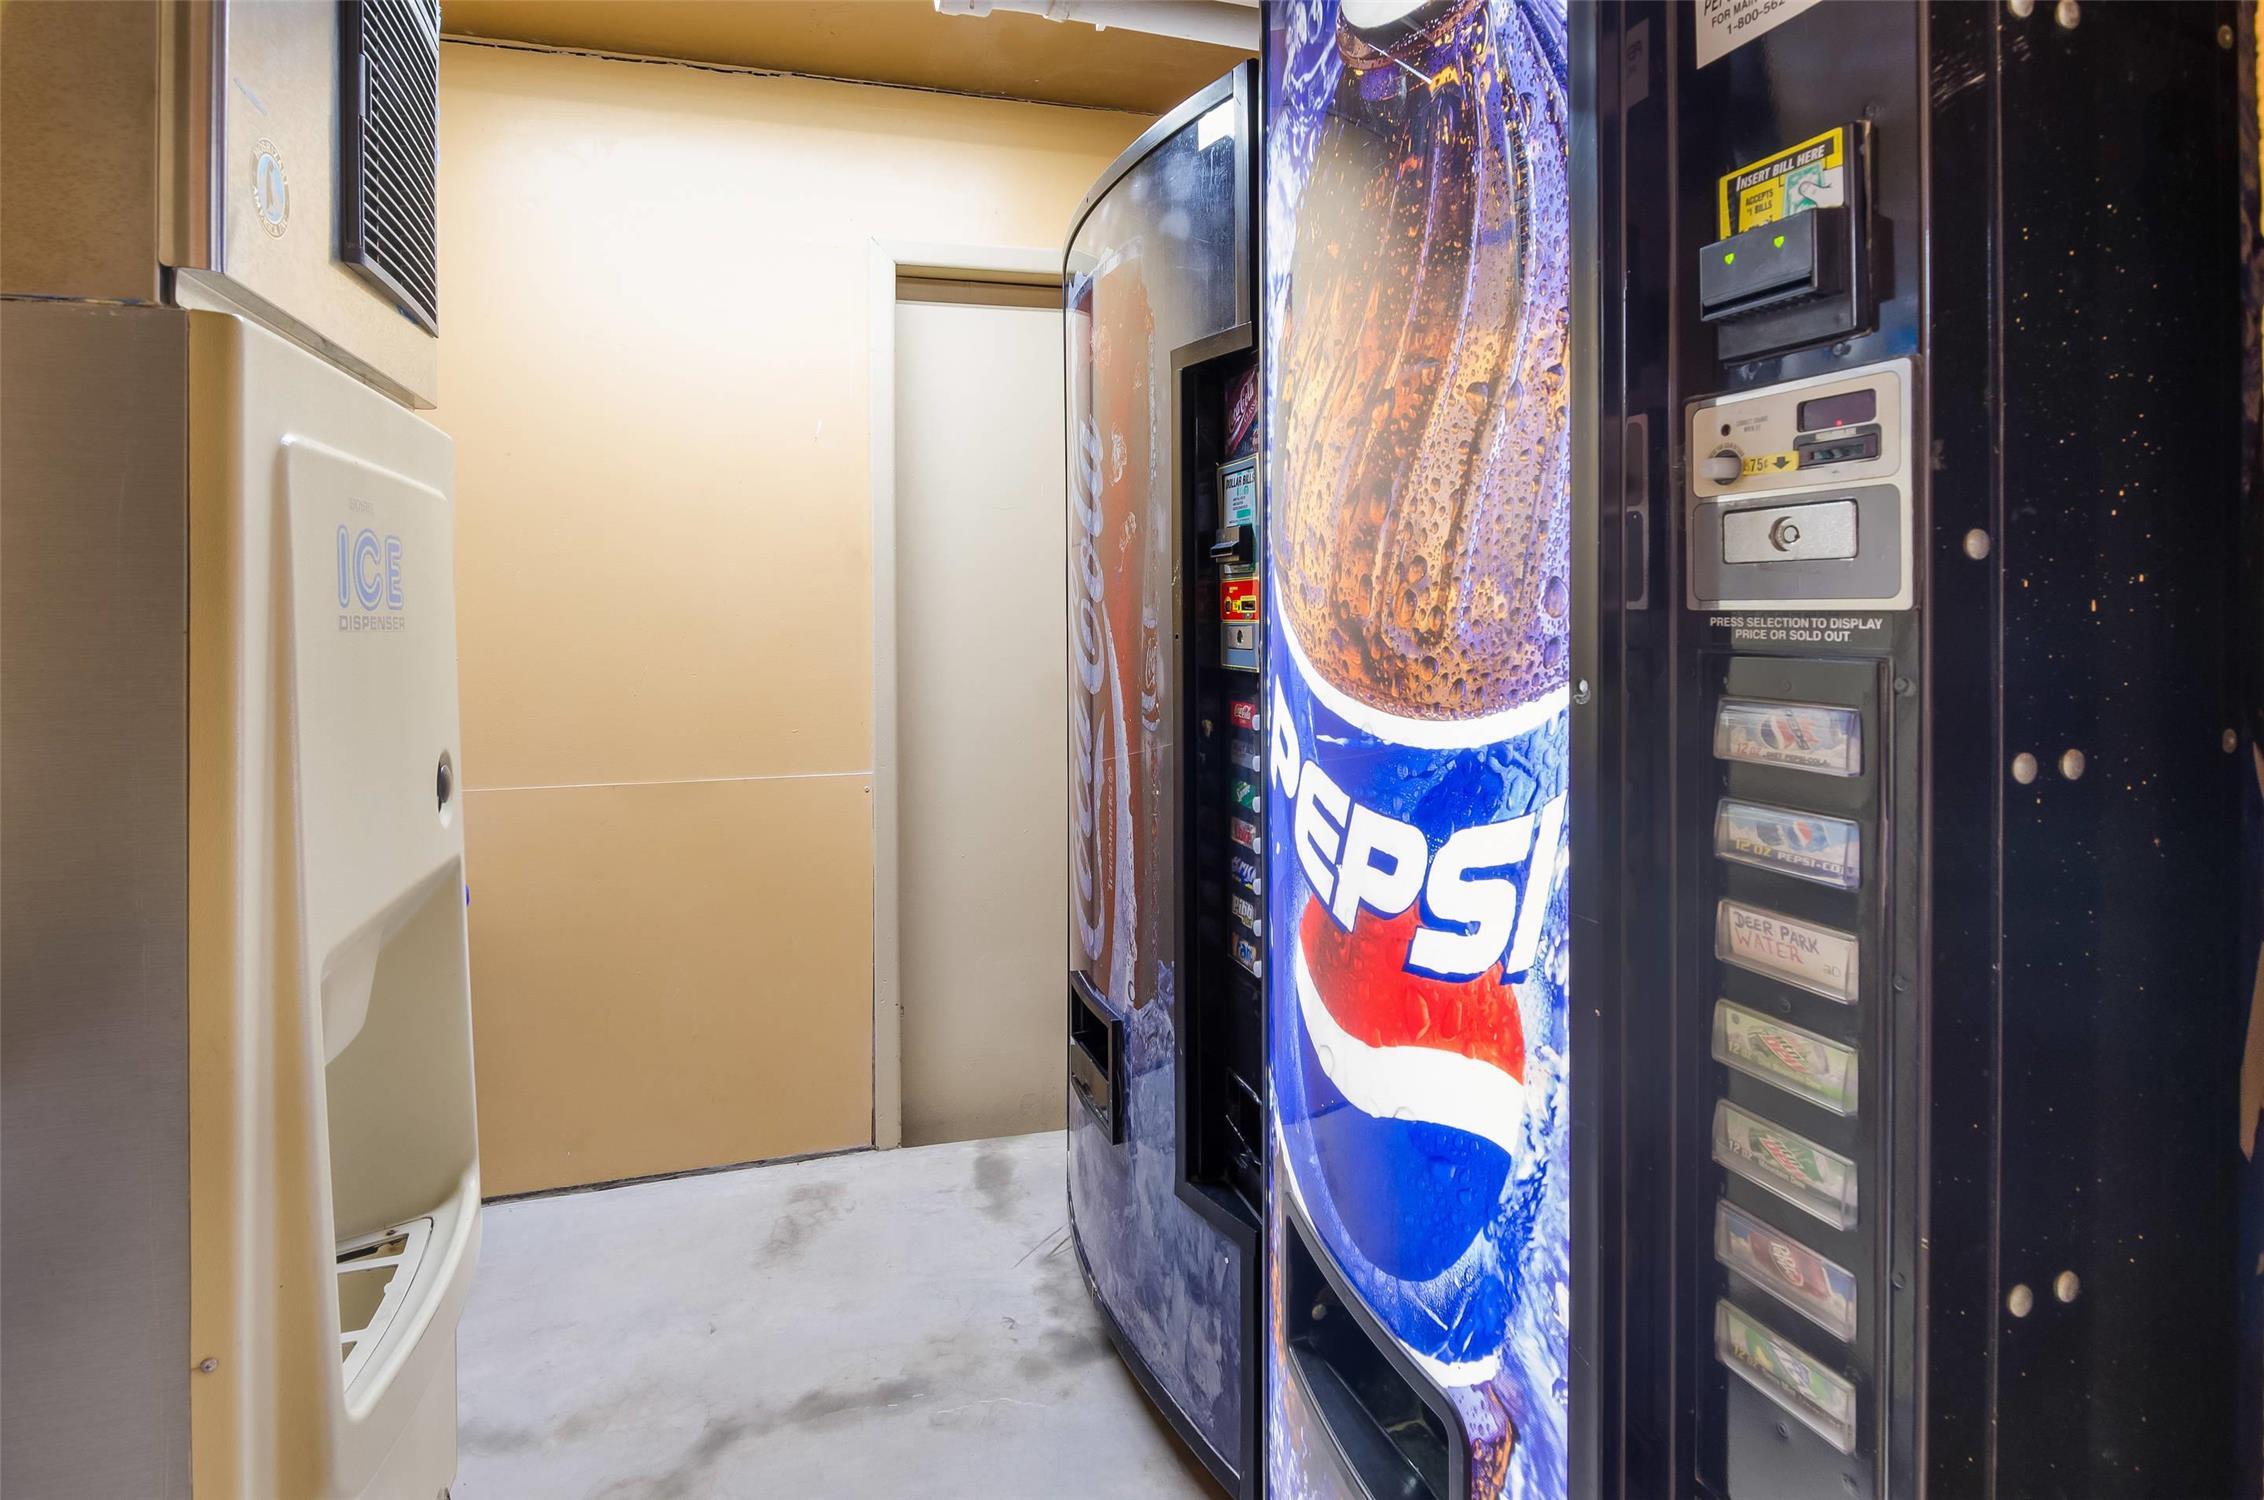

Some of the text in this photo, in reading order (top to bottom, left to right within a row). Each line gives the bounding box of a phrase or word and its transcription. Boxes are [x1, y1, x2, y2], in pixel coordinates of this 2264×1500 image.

[1711, 9, 1730, 28] FOR
[1736, 144, 1826, 192] INSERT BILL HERE
[336, 524, 404, 611] ICE
[339, 615, 405, 631] DISPENSER
[1710, 617, 1883, 629] PRESS SELECTION TO DISPLAY
[1735, 629, 1850, 642] PRICE OR SOLD OUT
[1270, 673, 1568, 975] PEPSI
[1777, 852, 1855, 876] PEPSI-CO
[1734, 911, 1820, 954] DEER PARK
[1735, 928, 1803, 964] WATER
